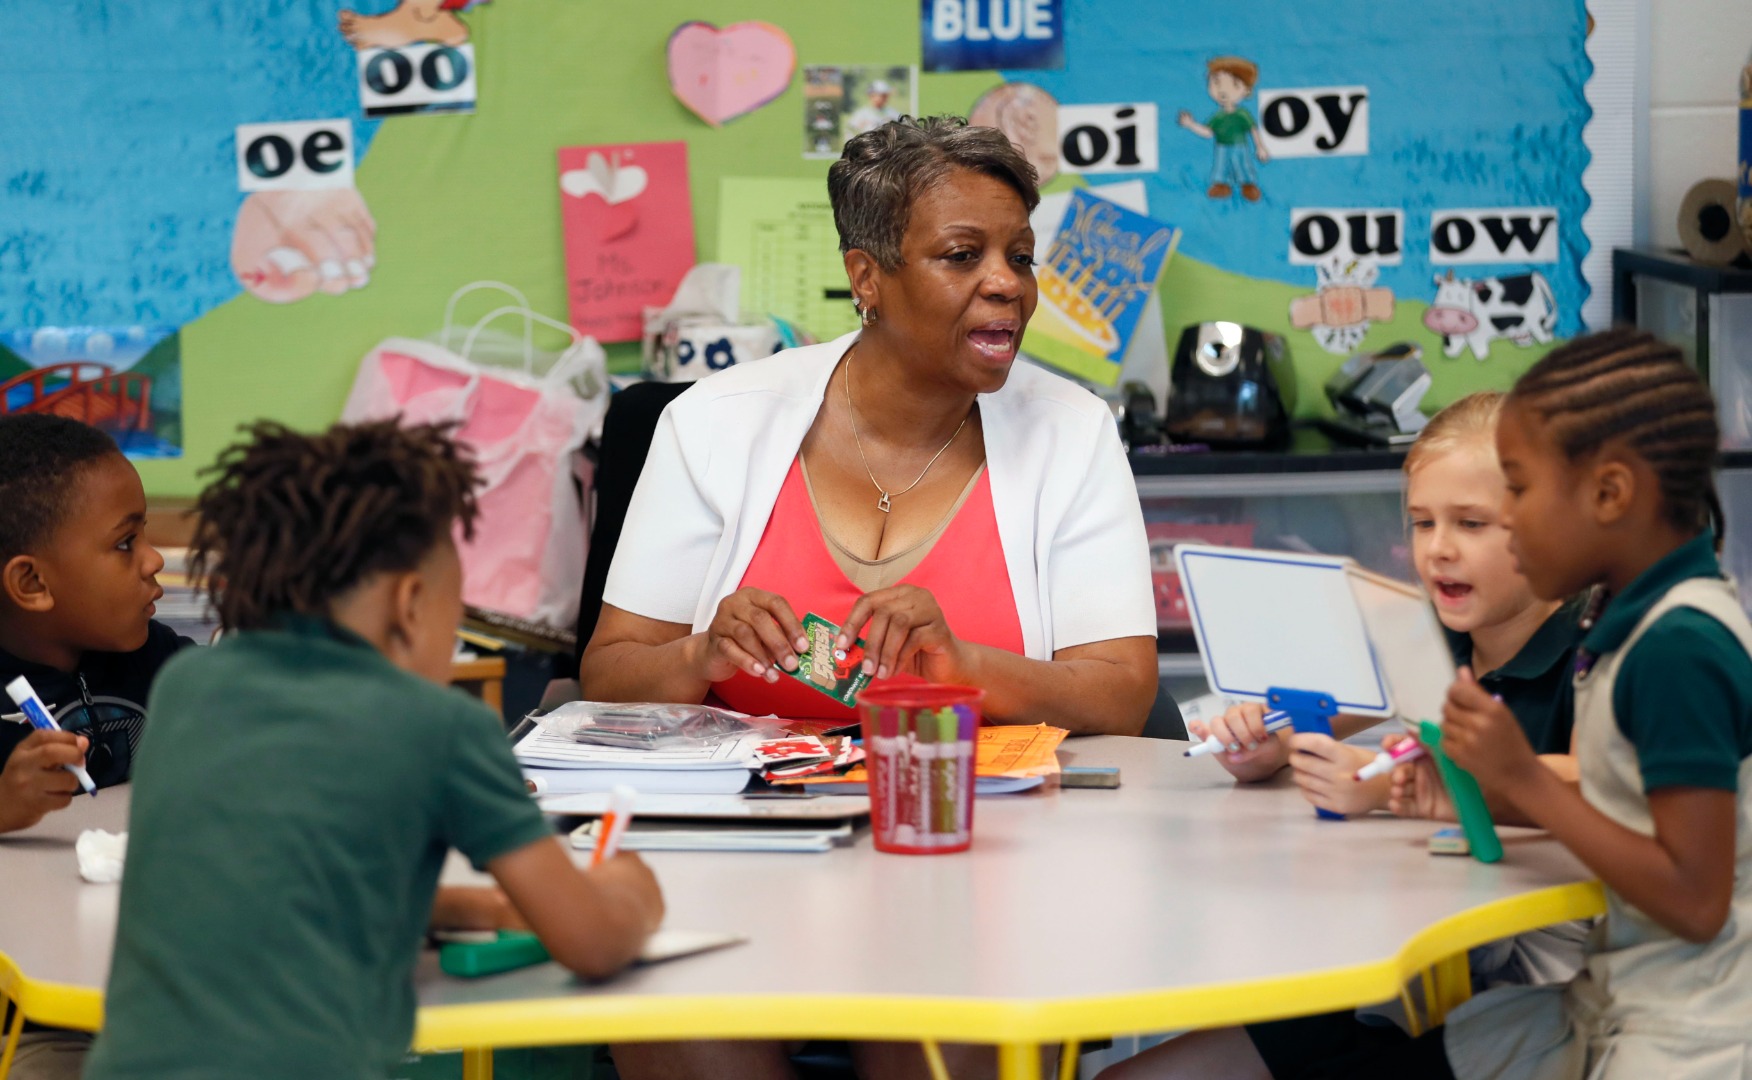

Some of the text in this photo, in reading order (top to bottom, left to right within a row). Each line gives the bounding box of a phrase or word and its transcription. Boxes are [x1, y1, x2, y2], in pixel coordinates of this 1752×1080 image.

[932, 0, 1053, 41] BLUE
[365, 48, 468, 96] oo
[1062, 107, 1142, 168] oi
[1263, 92, 1368, 152] oy
[245, 129, 346, 179] oe
[1289, 213, 1400, 257] ou
[1433, 214, 1557, 256] ow
[814, 622, 837, 682] SMASH
